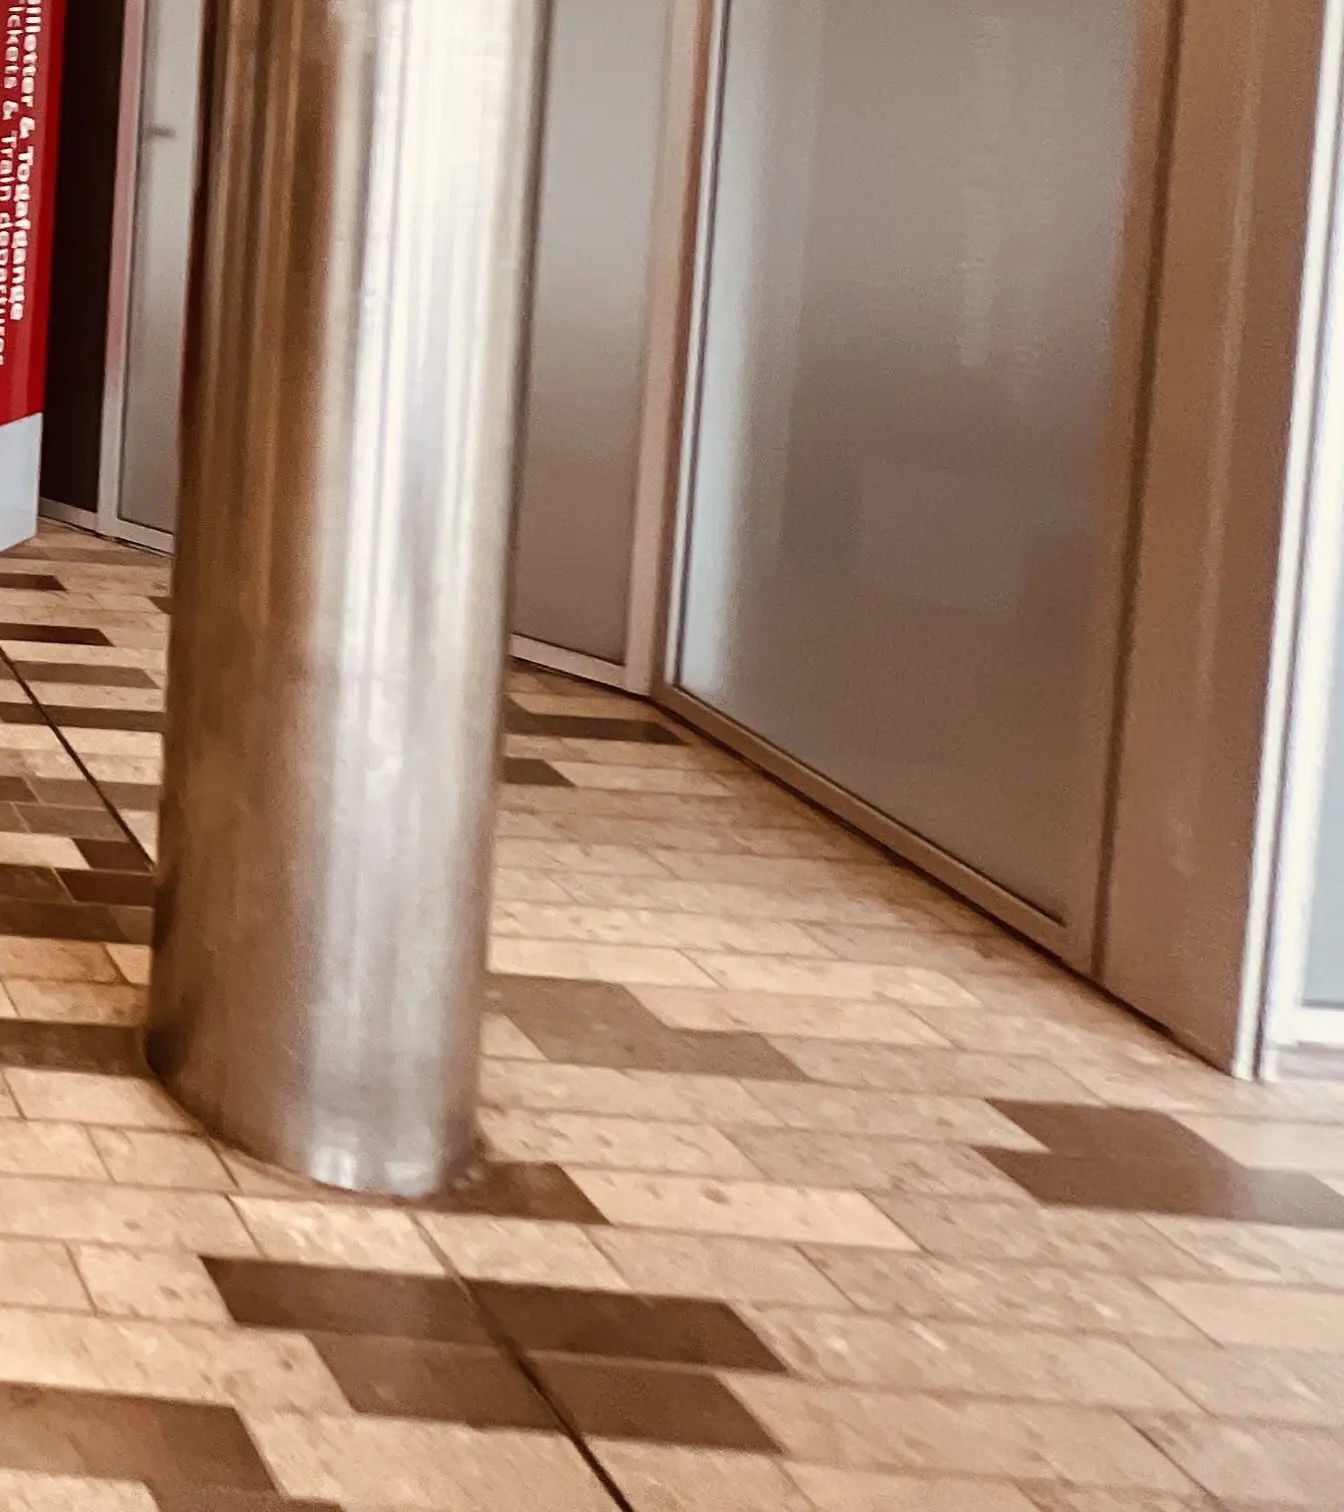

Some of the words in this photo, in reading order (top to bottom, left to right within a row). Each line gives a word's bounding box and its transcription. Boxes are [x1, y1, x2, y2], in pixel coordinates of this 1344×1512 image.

[2, 100, 19, 120] &
[19, 116, 36, 139] &
[7, 145, 34, 321] Togafgange
